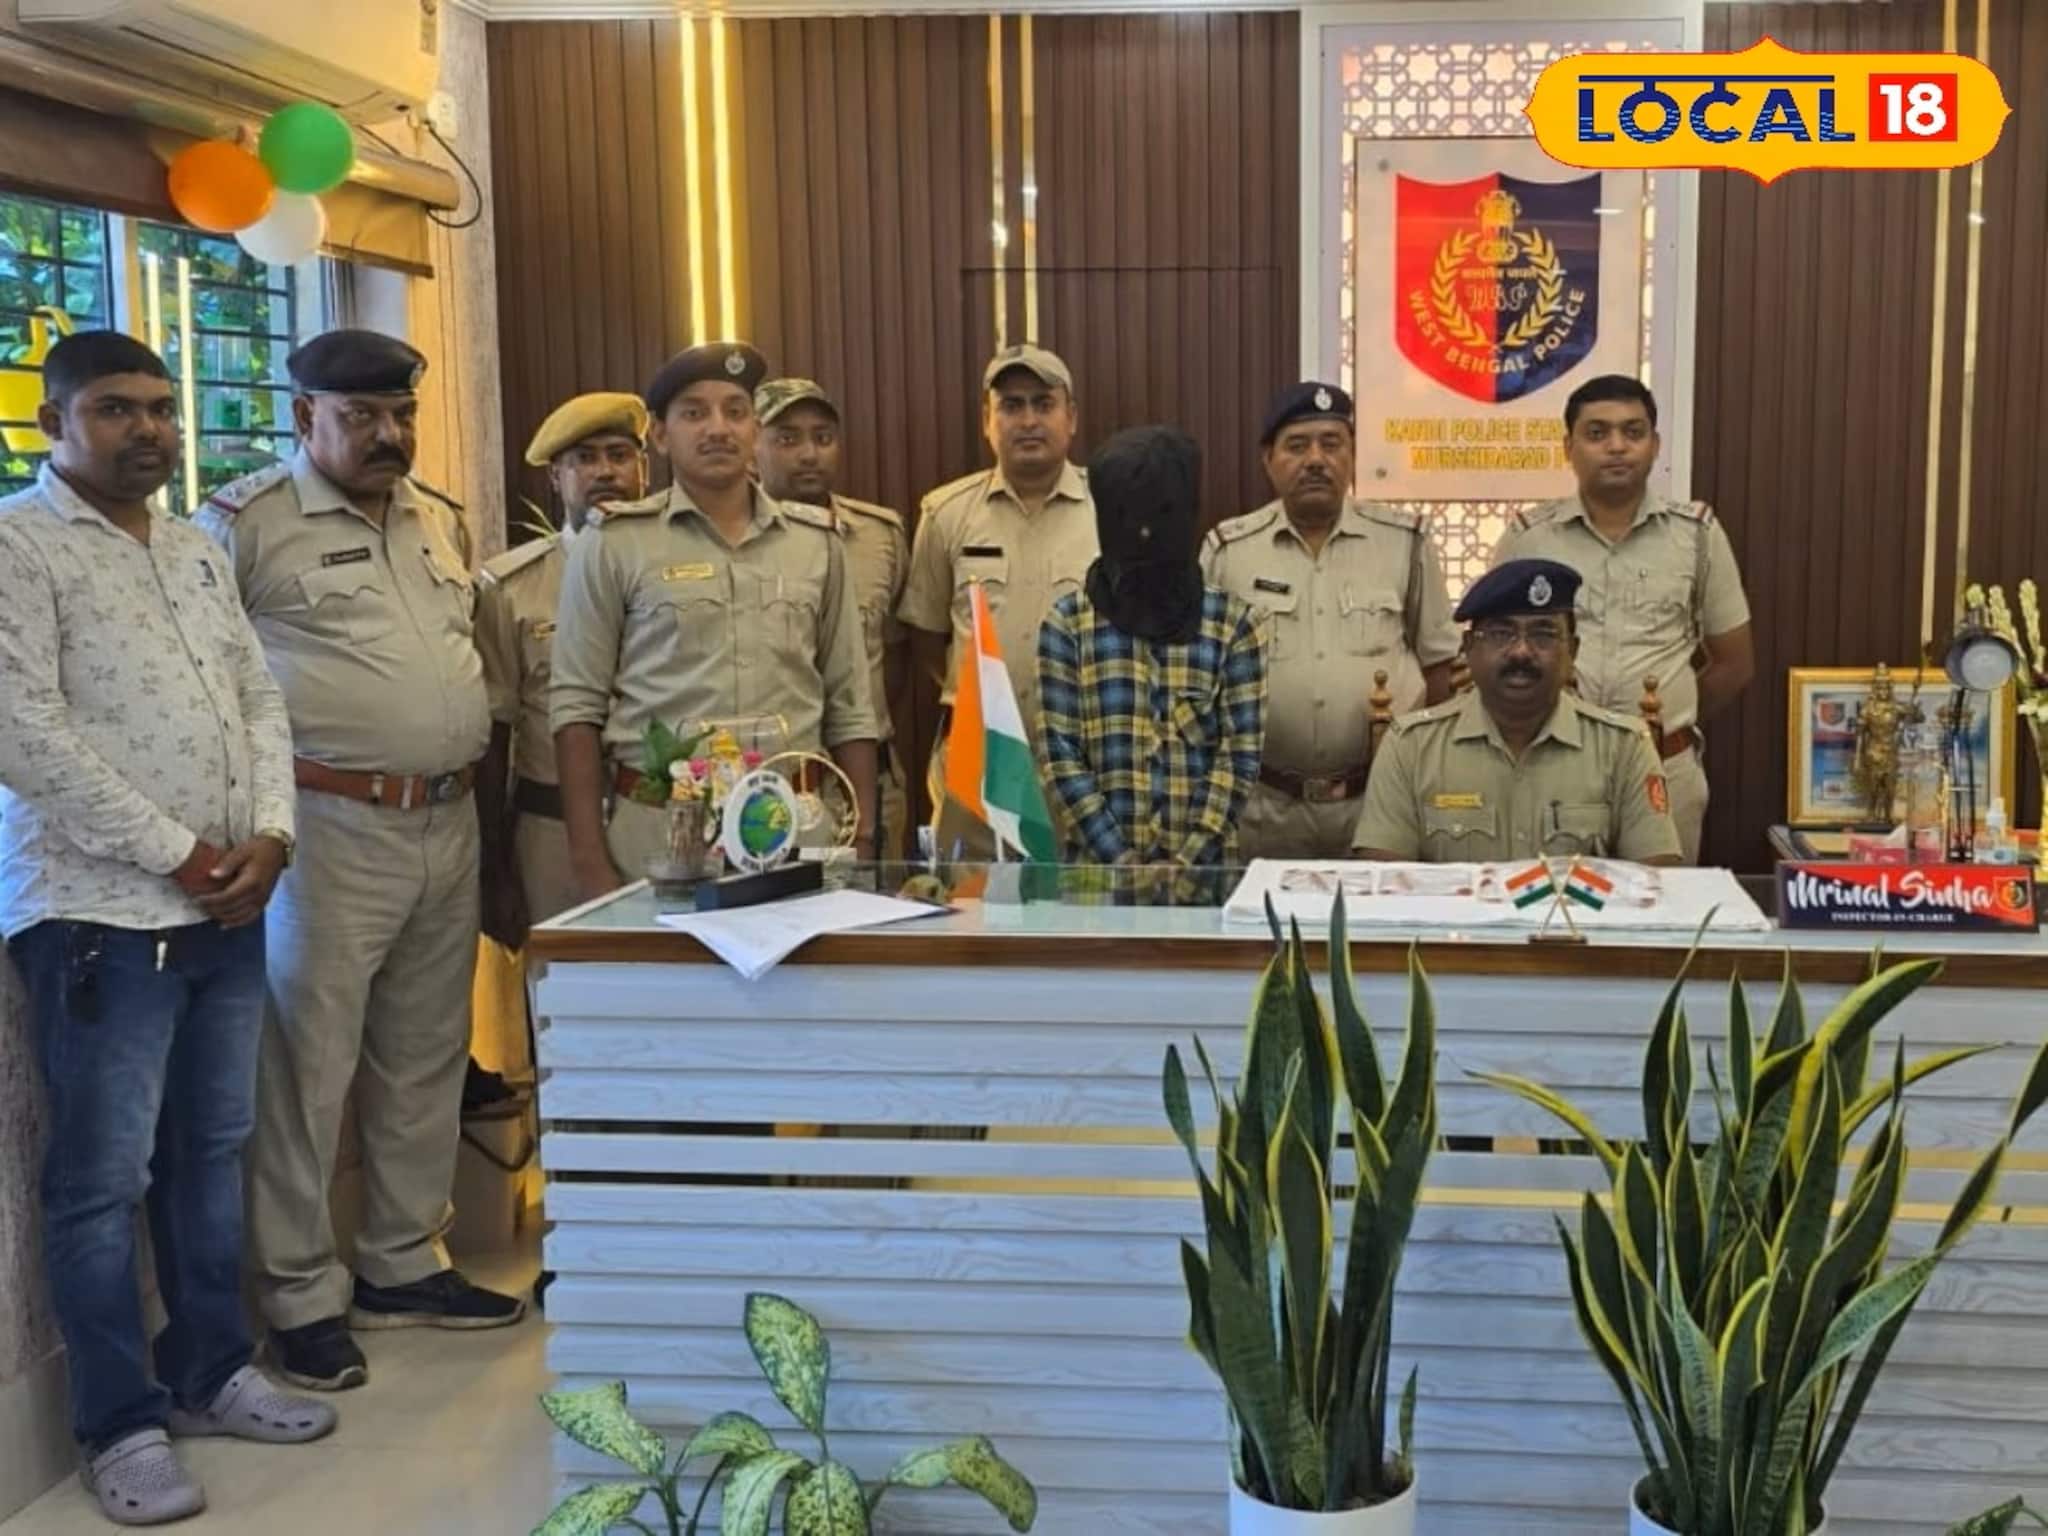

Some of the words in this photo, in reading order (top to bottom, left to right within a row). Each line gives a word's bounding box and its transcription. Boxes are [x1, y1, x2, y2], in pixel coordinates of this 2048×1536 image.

[1407, 290, 1444, 346] WEST
[1446, 344, 1530, 374] BENGAL
[1534, 289, 1586, 361] POLICE
[1450, 418, 1521, 442] POLICE
[1787, 870, 1891, 909] Mrinal
[1897, 869, 1995, 914] Sinha
